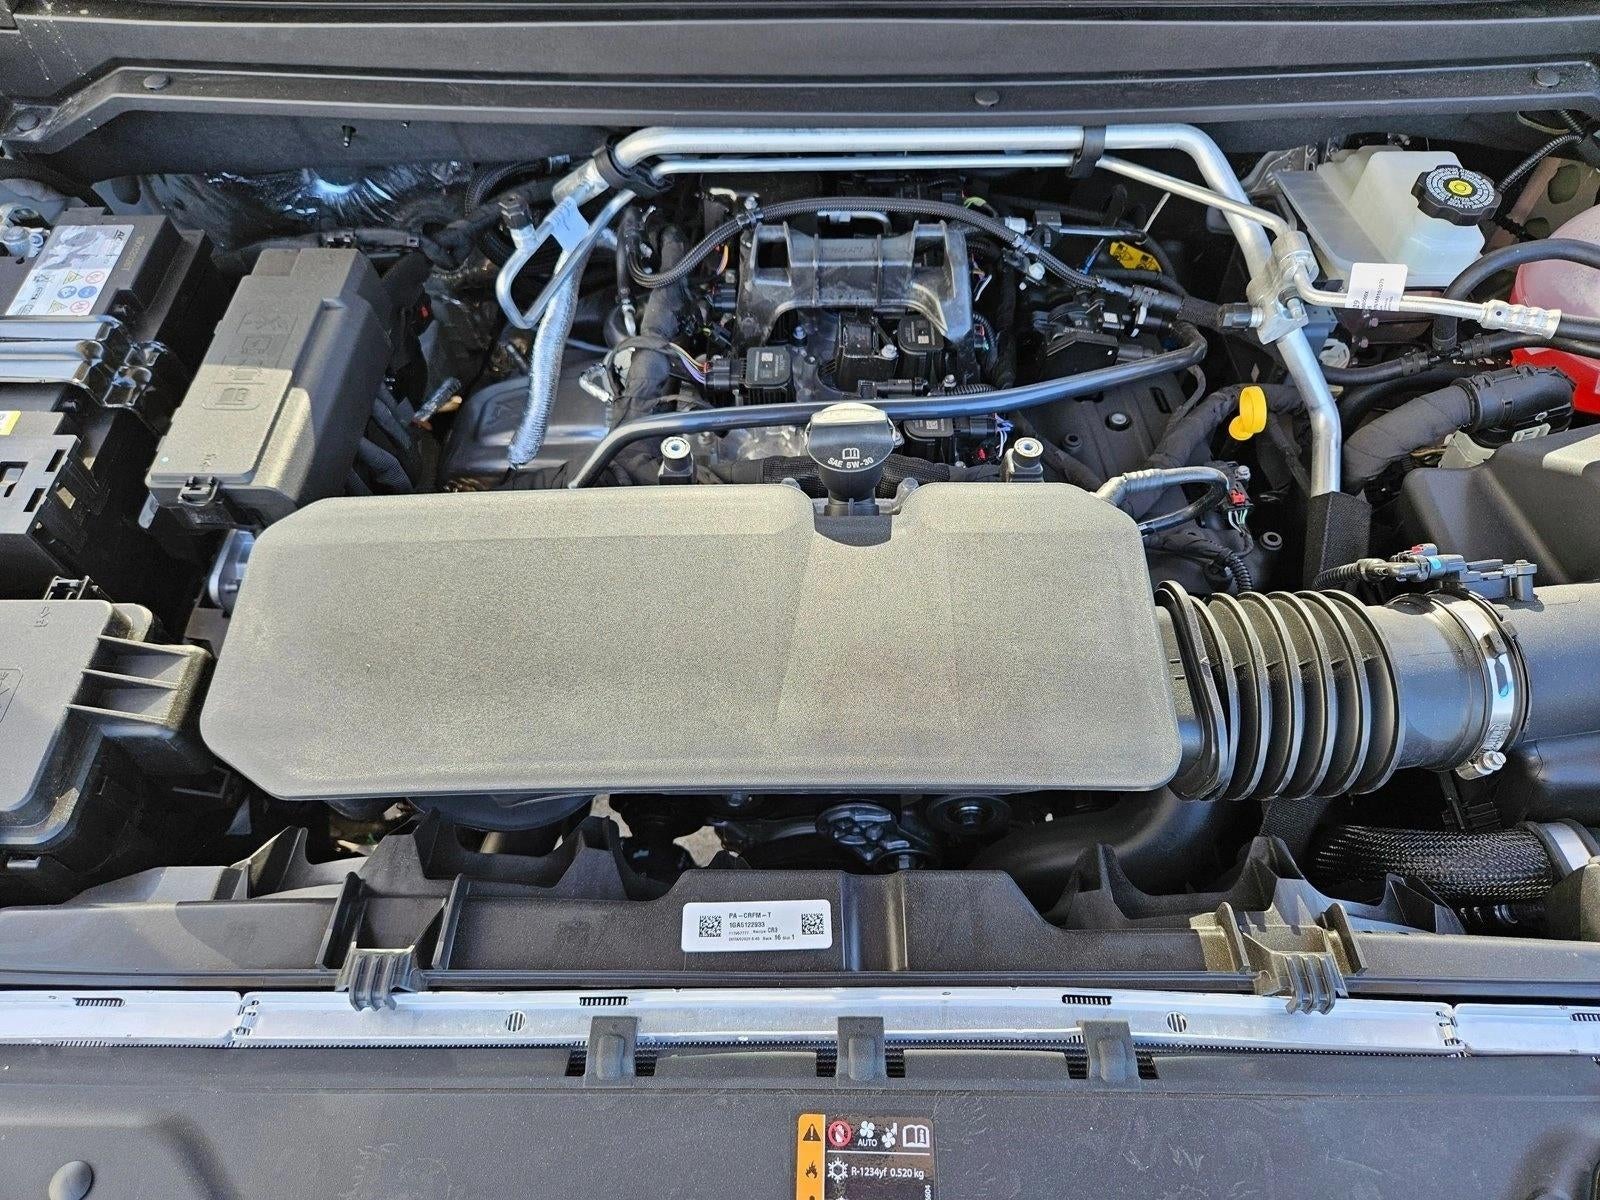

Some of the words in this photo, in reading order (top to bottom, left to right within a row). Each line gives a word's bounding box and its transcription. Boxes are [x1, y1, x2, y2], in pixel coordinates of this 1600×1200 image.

[828, 458, 844, 468] SAE
[846, 457, 874, 468] 5W-30
[857, 1138, 878, 1147] AUTO
[851, 1166, 887, 1179] R-1234yf
[890, 1166, 913, 1178] 0.520
[913, 1168, 925, 1181] kg
